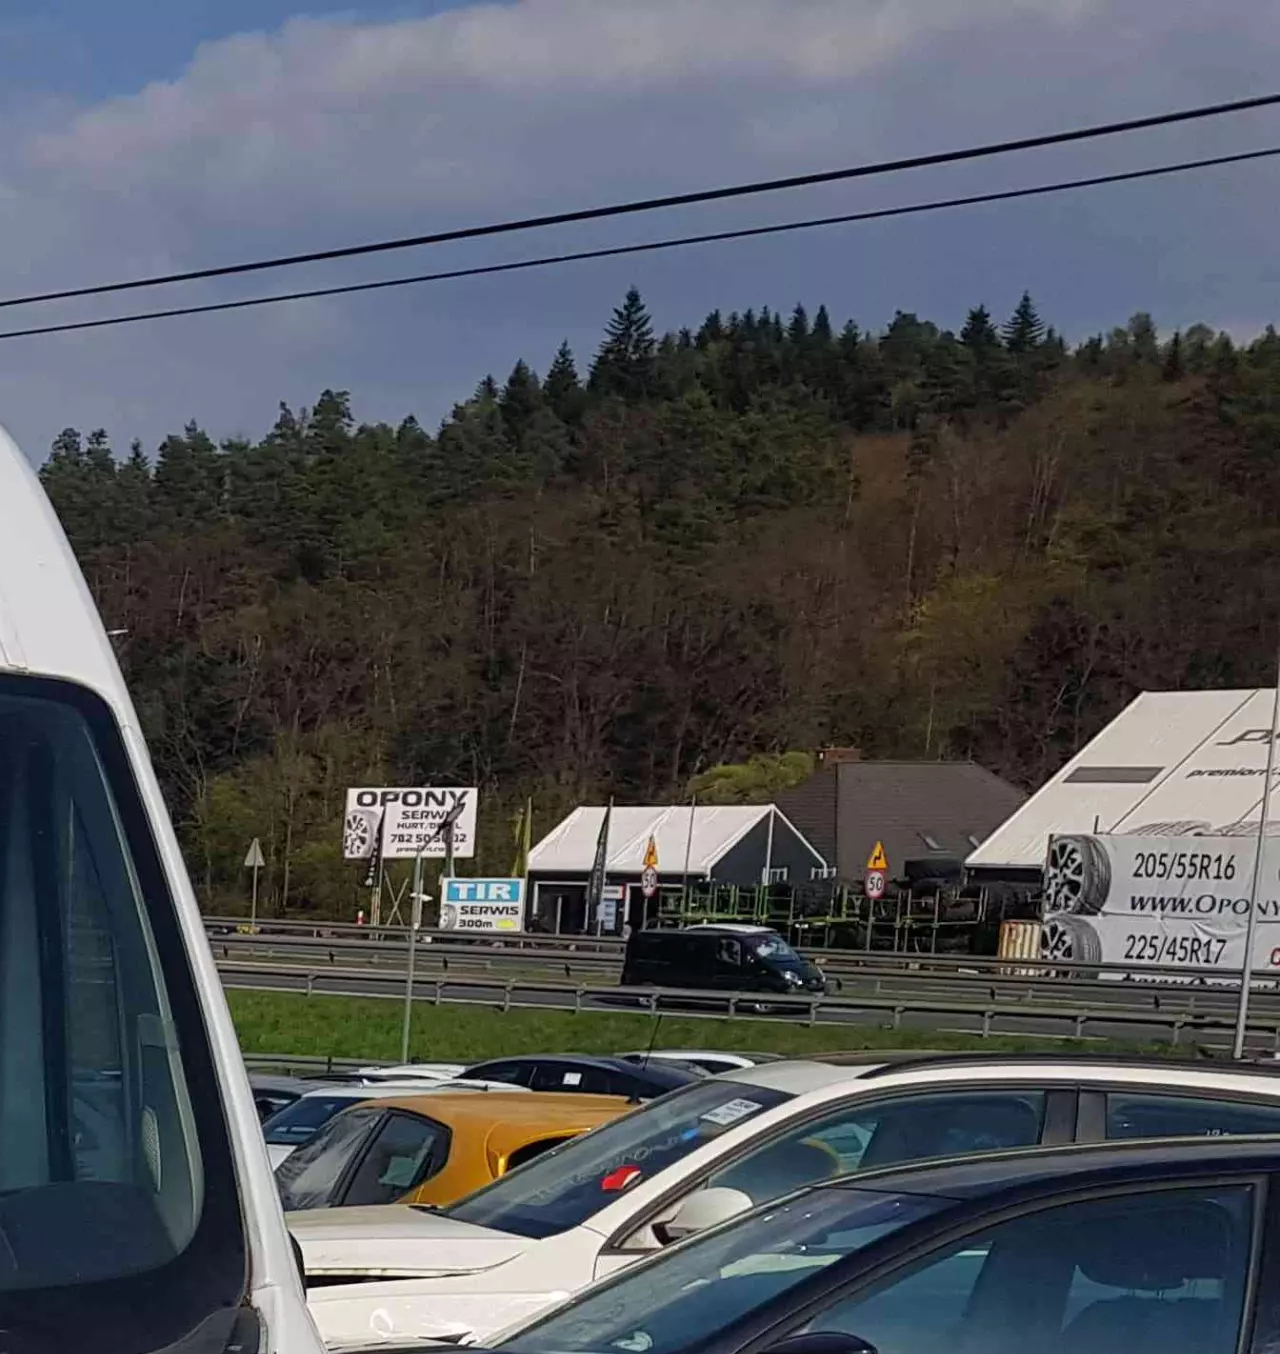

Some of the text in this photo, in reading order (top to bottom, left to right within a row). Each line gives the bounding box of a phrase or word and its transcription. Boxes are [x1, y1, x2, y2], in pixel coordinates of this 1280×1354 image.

[356, 790, 470, 808] OPONY
[401, 810, 456, 820] SERW
[1133, 853, 1236, 880] 205/55R16
[452, 883, 511, 900] TIR
[869, 876, 882, 891] 50
[460, 905, 519, 915] SERWIS
[458, 919, 493, 928] 300m
[1124, 935, 1227, 964] 225/45R17
